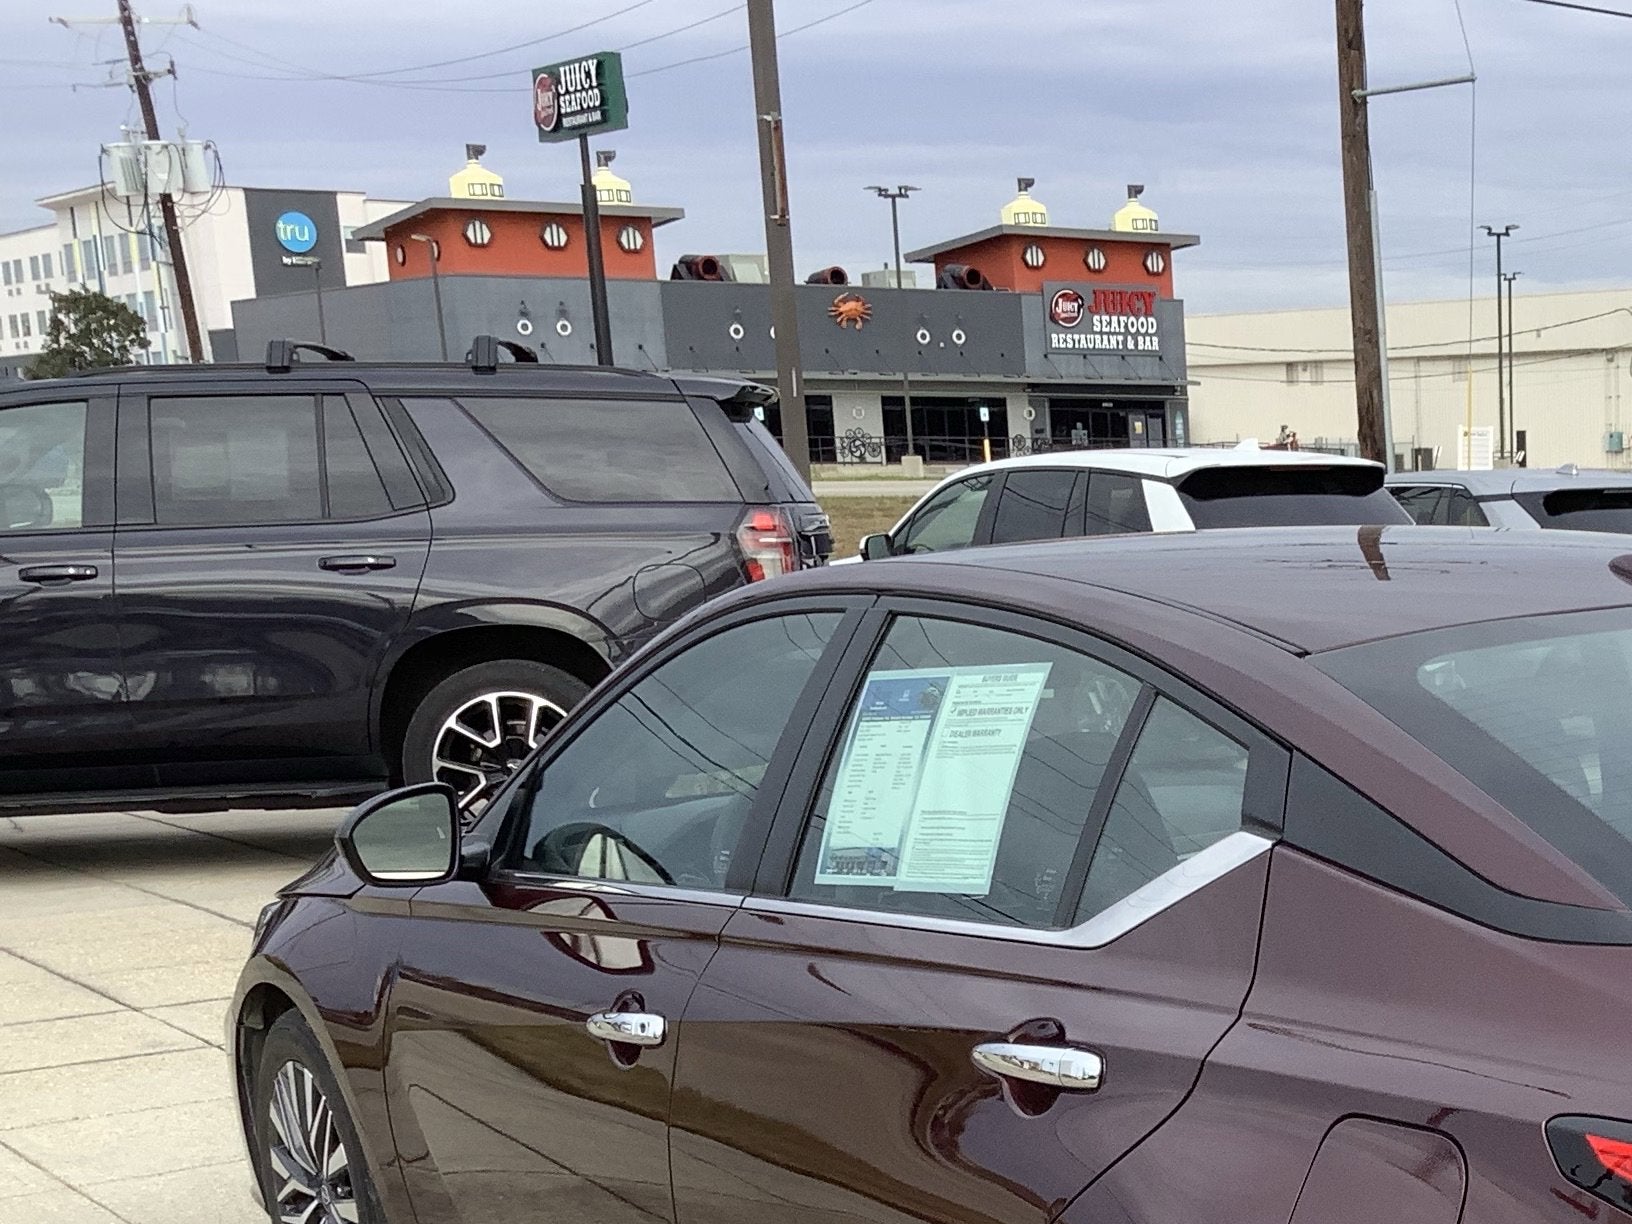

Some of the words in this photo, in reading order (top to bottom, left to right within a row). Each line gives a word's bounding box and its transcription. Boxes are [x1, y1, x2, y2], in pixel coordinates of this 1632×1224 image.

[557, 59, 598, 94] JUICY
[559, 88, 601, 114] SEAFOOD
[277, 220, 310, 241] tru
[1088, 288, 1157, 316] JUICY
[1092, 315, 1158, 334] SEAFOOD
[1051, 333, 1124, 350] RESTAURANT
[1126, 335, 1135, 350] &
[1137, 335, 1160, 351] BAR
